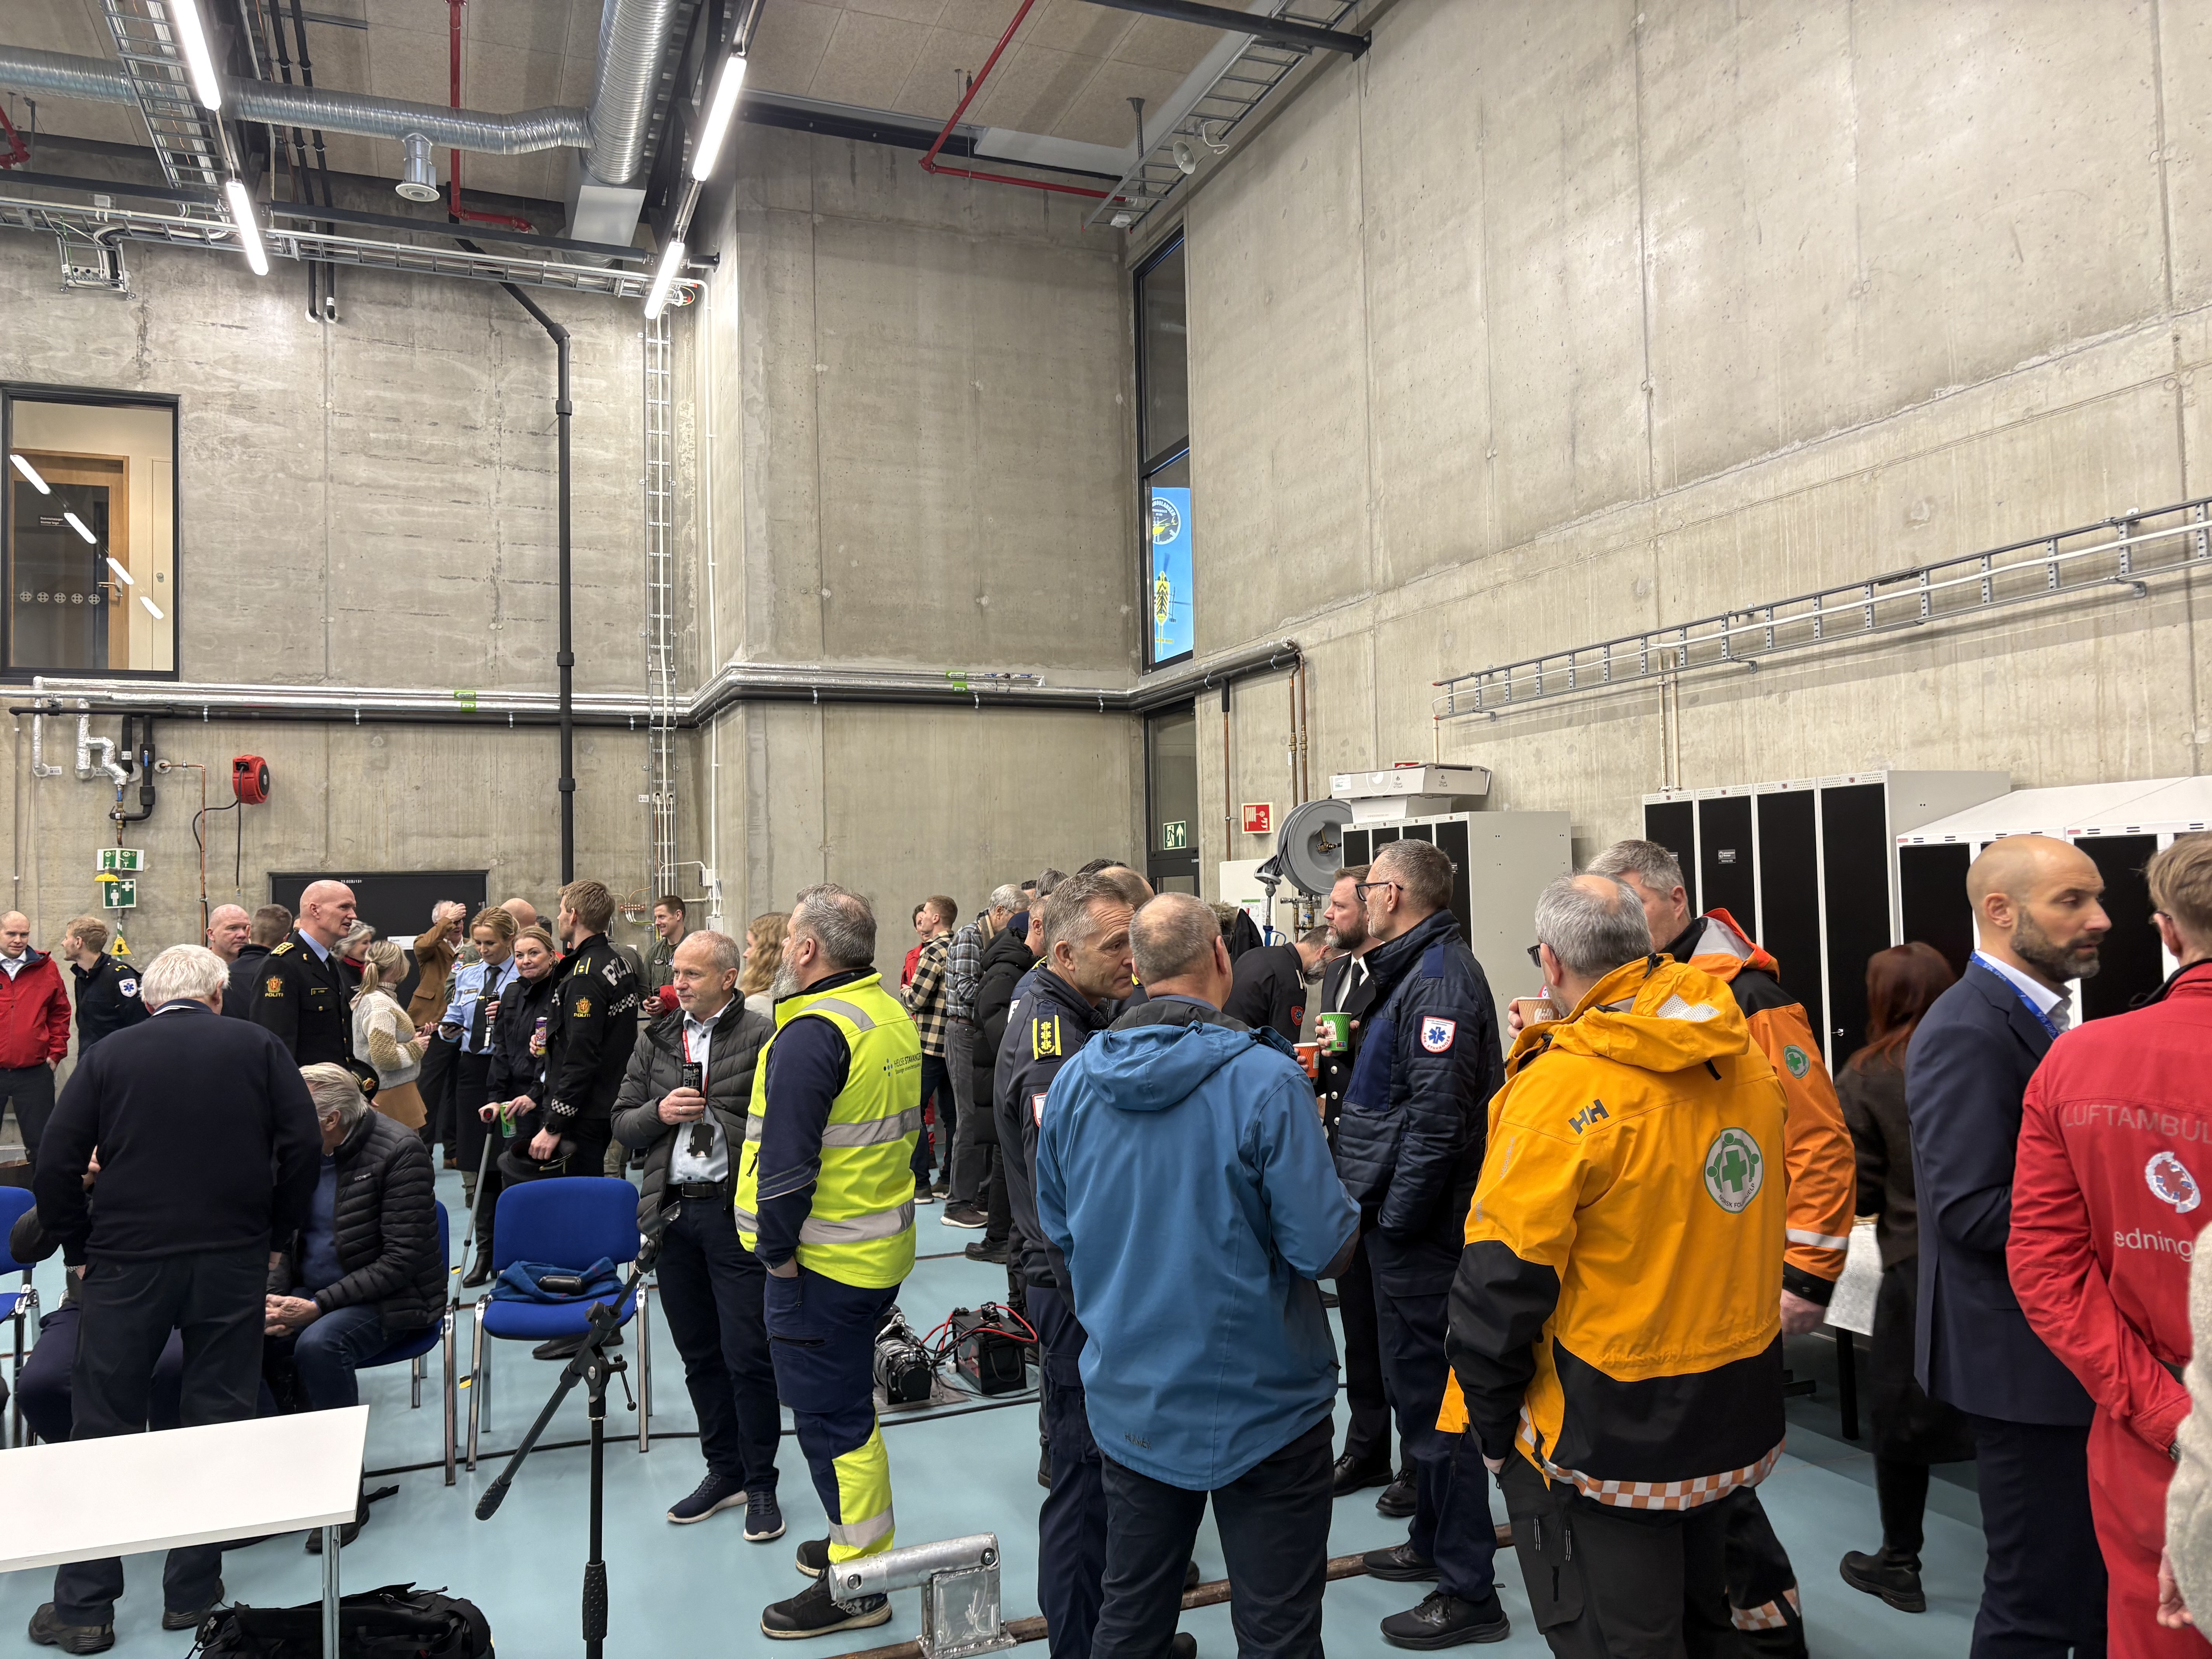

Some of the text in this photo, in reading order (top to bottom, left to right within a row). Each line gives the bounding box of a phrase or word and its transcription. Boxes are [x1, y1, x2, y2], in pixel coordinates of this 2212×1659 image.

[894, 1057, 905, 1068] HELSE
[1568, 1099, 1609, 1135] HH
[2114, 1228, 2194, 1262] edning
